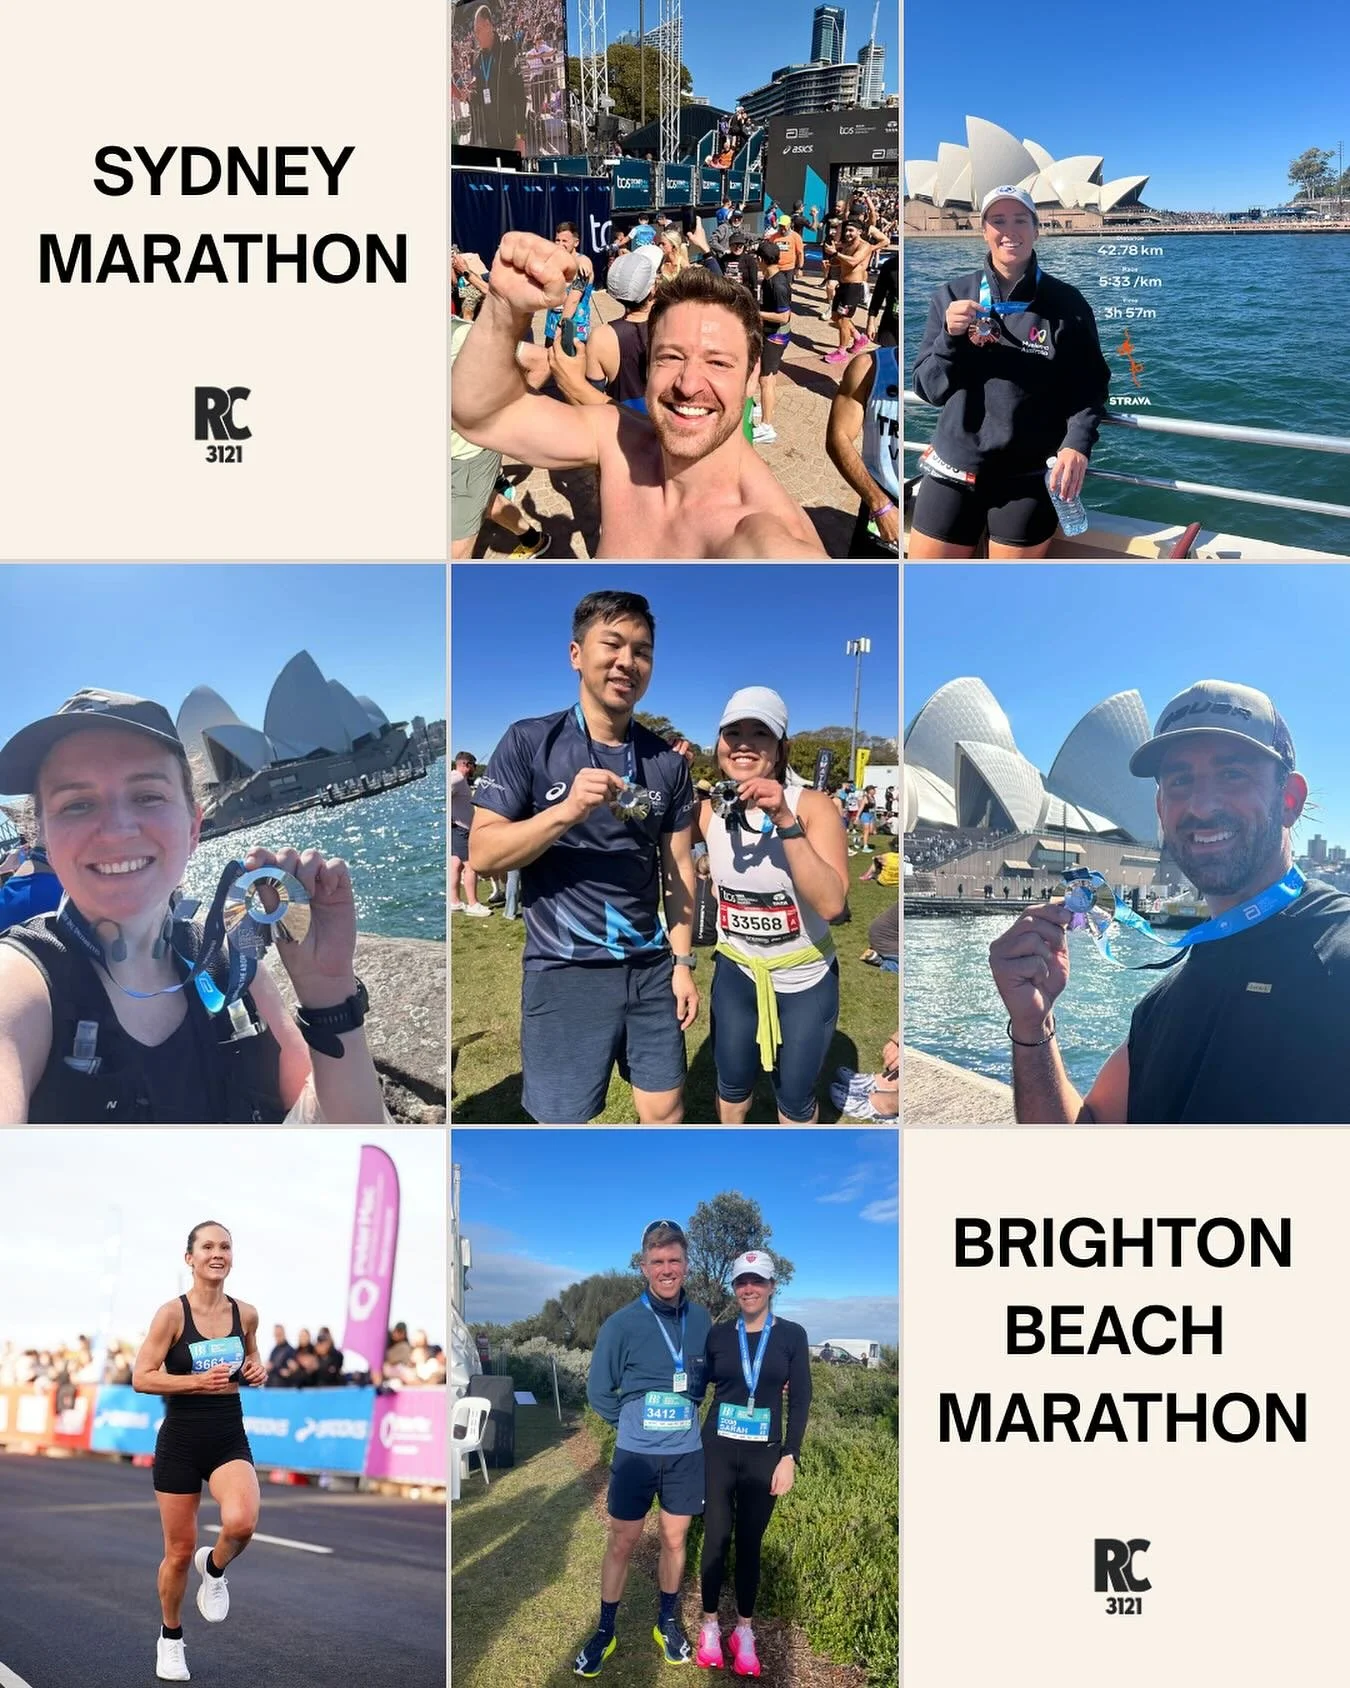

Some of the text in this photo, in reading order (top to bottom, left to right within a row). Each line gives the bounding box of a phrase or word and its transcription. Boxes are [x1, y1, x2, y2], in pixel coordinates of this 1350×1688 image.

[792, 145, 813, 153] asics
[617, 175, 631, 189] tcs
[731, 913, 782, 931] 33568
[647, 1408, 676, 1419] 3412
